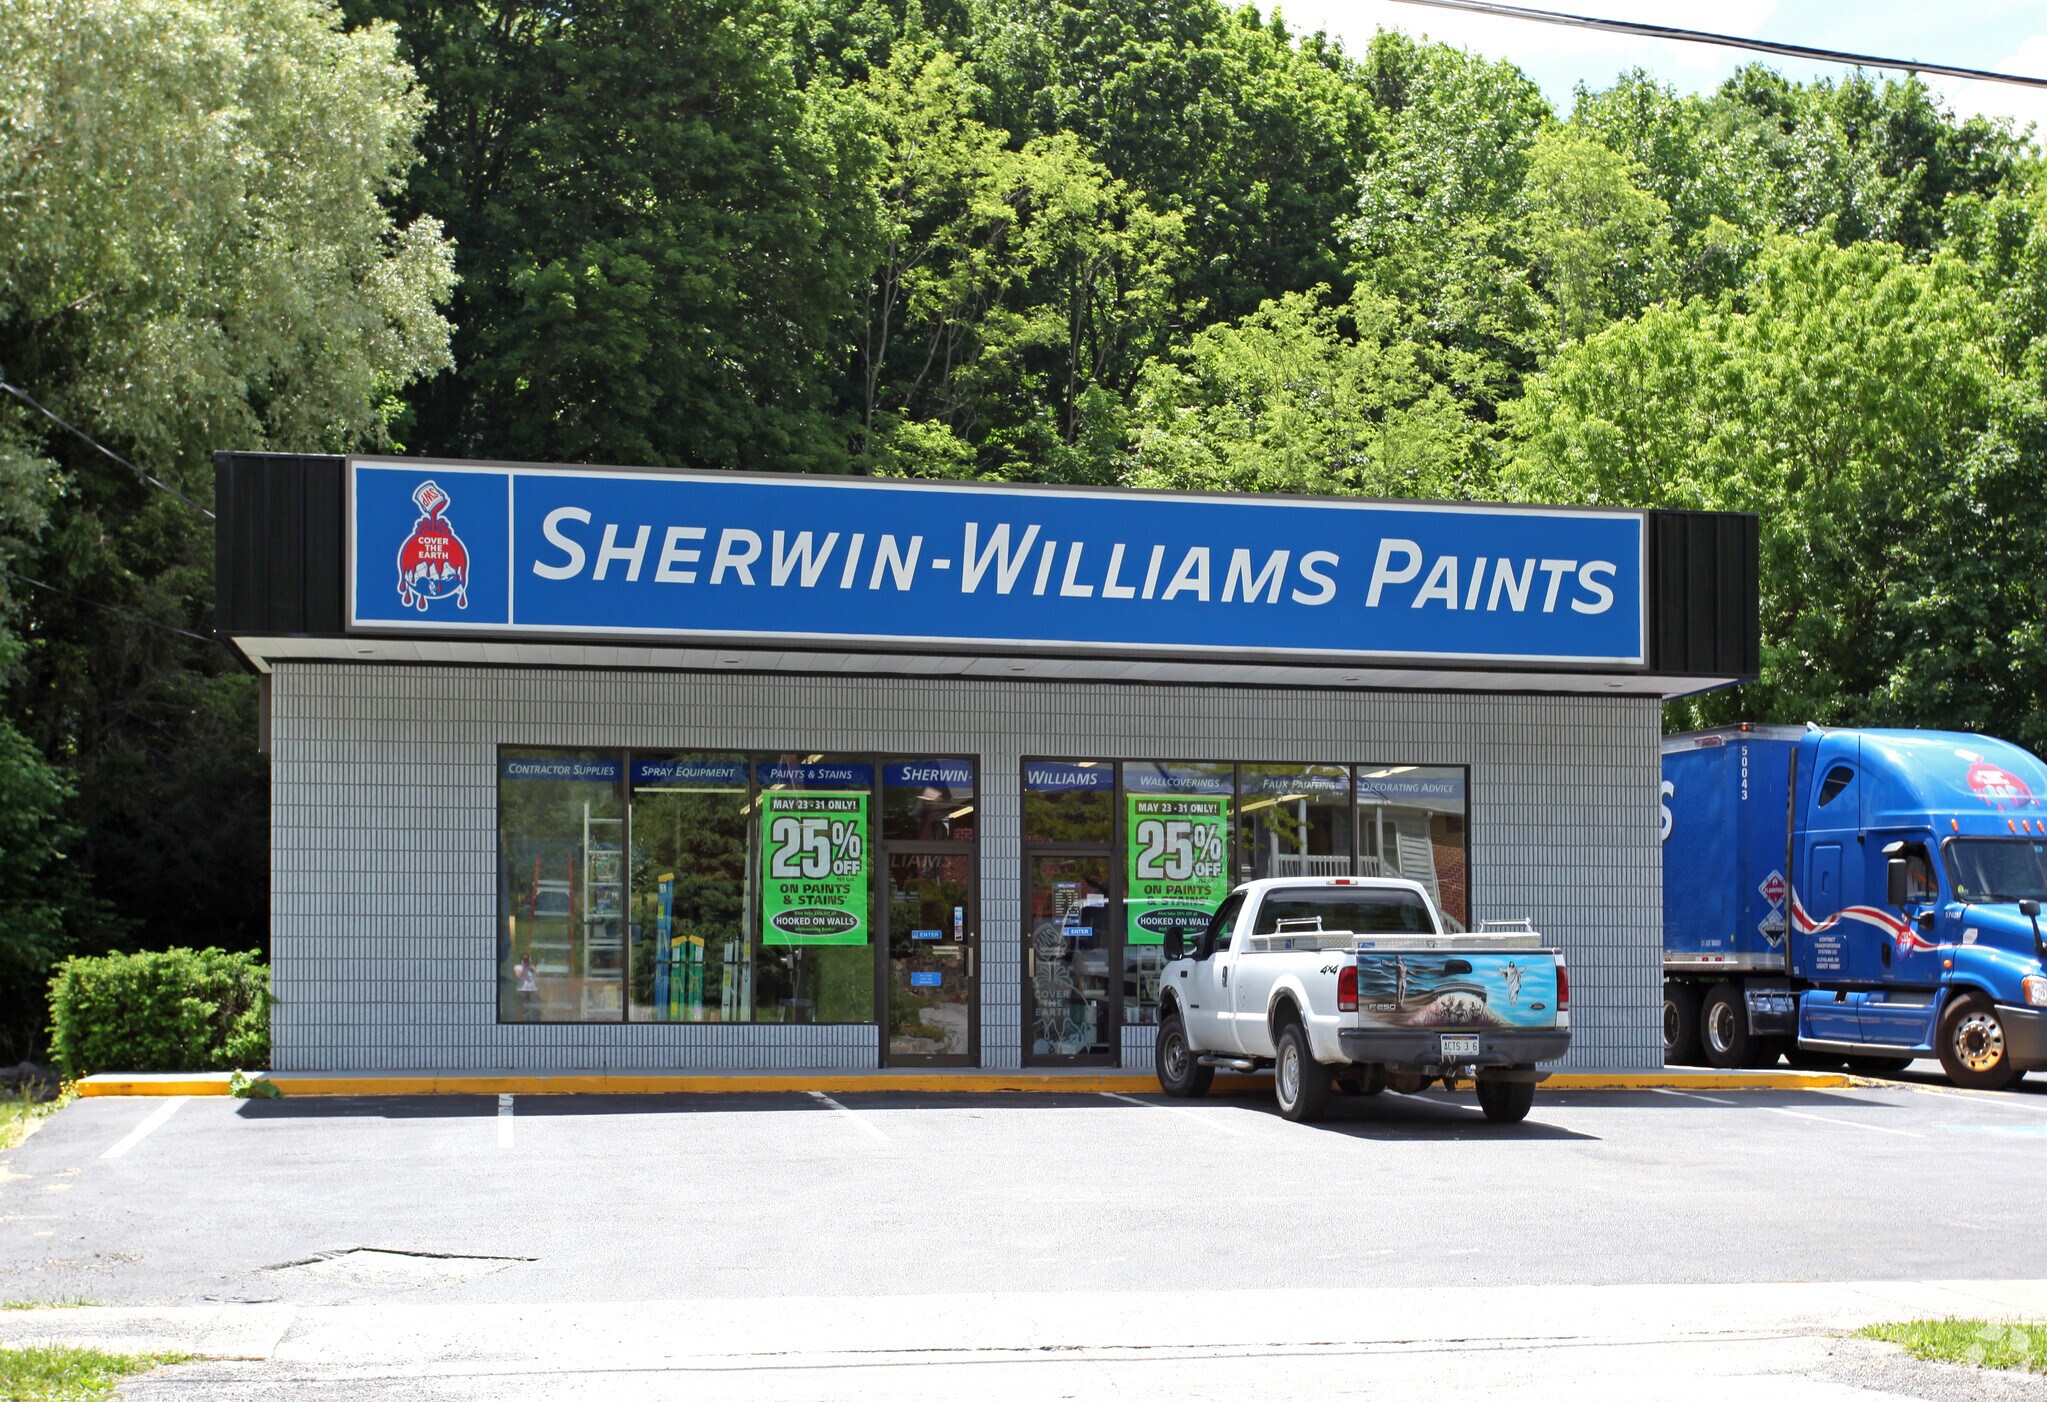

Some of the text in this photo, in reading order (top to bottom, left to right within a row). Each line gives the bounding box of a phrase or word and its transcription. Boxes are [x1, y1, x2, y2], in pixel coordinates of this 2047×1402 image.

[418, 537, 449, 545] COVER
[532, 506, 1617, 615] SHERWIN-WILLIAMS PAINTS
[508, 763, 615, 776] CONTRACTOR SUPPLIES
[641, 766, 735, 777] SPRAY EQUIPMENT
[770, 768, 852, 779] PAINTS & STAINS
[902, 766, 972, 782] SHERWIN-
[1028, 770, 1098, 785] WILLIAMS
[1140, 775, 1220, 787] WALLCOVERINGS
[1262, 779, 1335, 790] FAUX PAINTING
[1362, 781, 1454, 793] DECORATING ADVICE
[773, 799, 795, 809] MAY
[797, 800, 808, 809] 23
[815, 800, 825, 809] 31
[828, 800, 857, 810] ONLY!
[1138, 803, 1159, 812] MAY
[1161, 803, 1172, 812] 23
[1178, 804, 1188, 812] 31
[1190, 804, 1217, 813] ONLY!
[770, 816, 862, 880] 25%
[1136, 818, 1223, 881] 25%
[832, 860, 862, 876] OFF
[1194, 861, 1222, 877] OFF
[780, 884, 851, 894] ON PAINTS
[1144, 885, 1212, 895] ON PAINTS
[783, 895, 793, 905] &
[1147, 896, 1157, 906] &
[776, 917, 854, 926] HOOKED ON WALLS
[1140, 917, 1212, 926] HOOKED ON WALL
[1034, 990, 1071, 998] COVER
[1043, 999, 1063, 1007] THE
[1035, 1008, 1071, 1016] EARTH
[1443, 1041, 1461, 1051] ACTS
